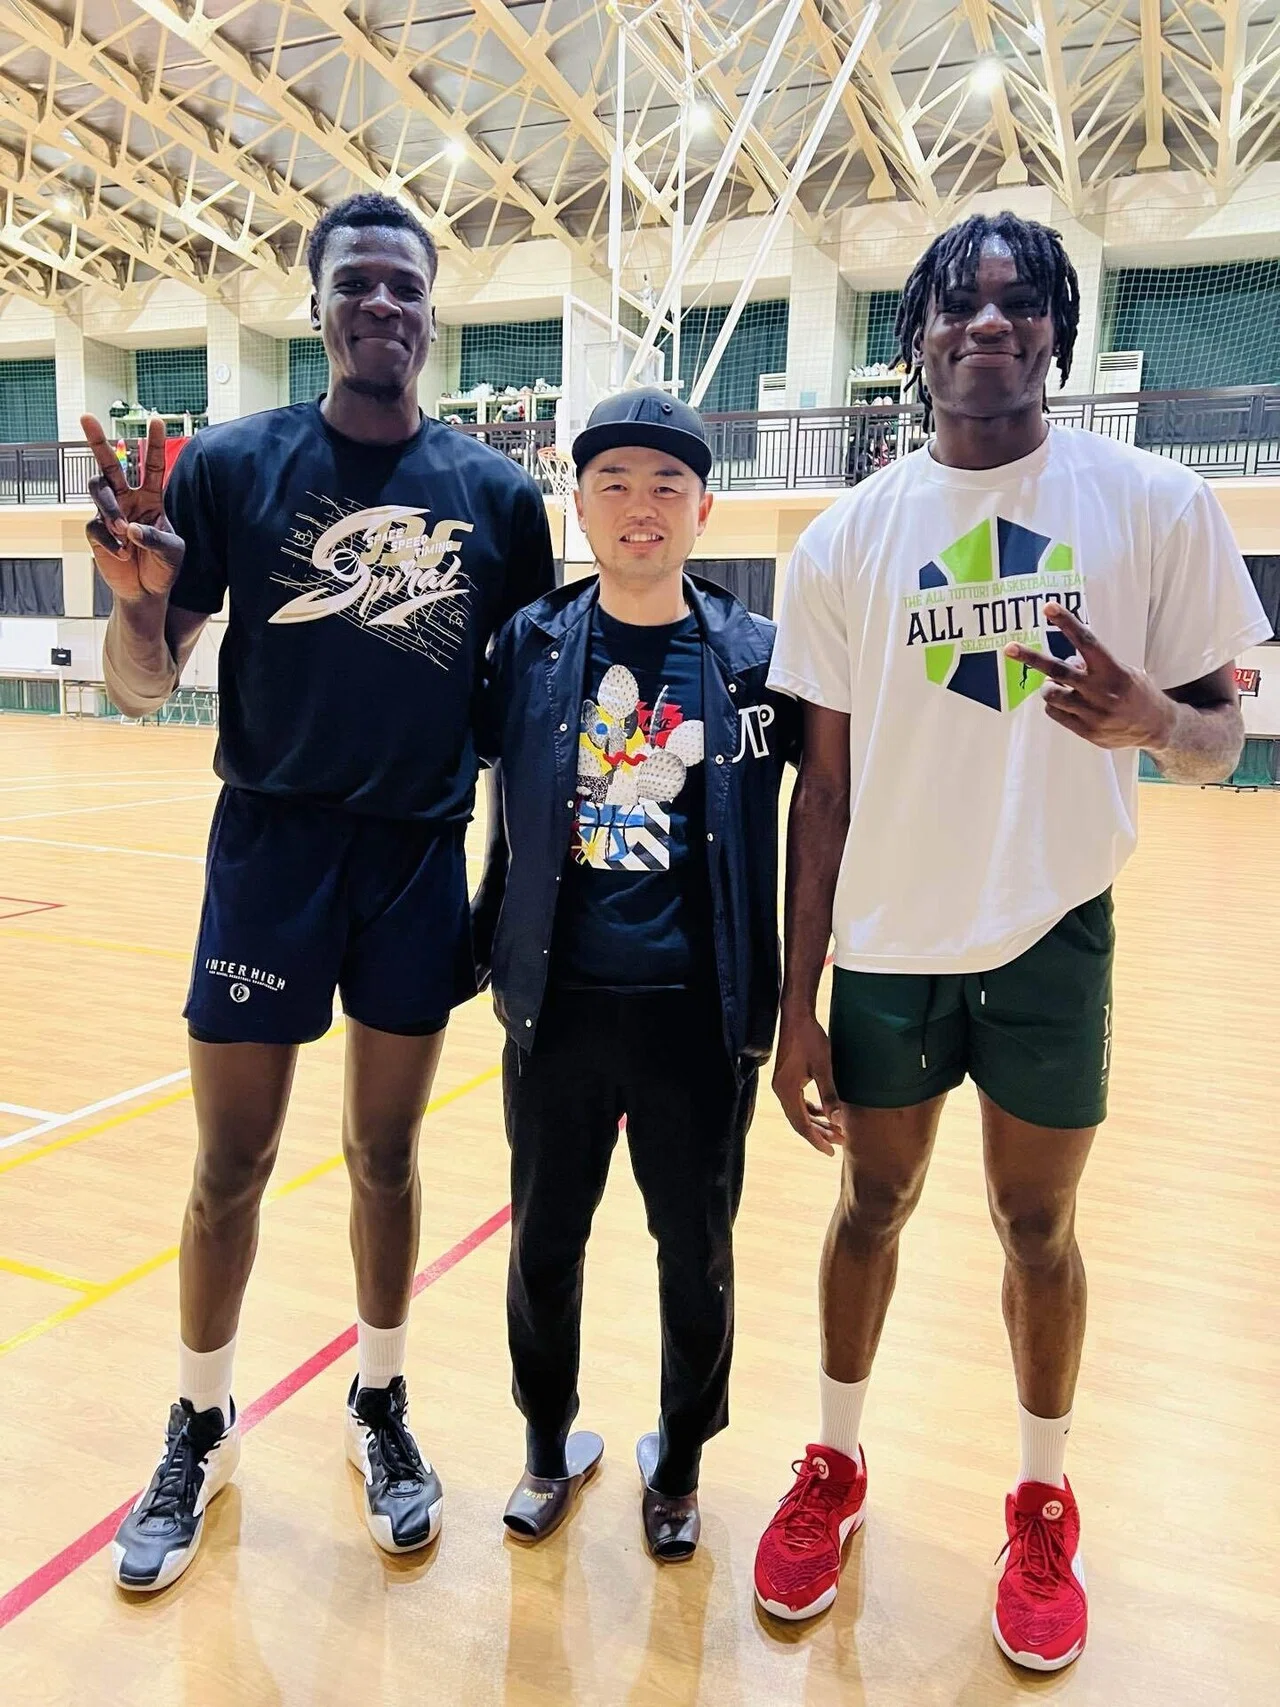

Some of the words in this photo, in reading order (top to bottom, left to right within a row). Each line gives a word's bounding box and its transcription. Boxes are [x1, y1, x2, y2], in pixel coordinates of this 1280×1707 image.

[390, 533, 428, 553] SPEED
[415, 540, 453, 560] TIMING
[902, 594, 922, 610] THE
[926, 590, 945, 605] ALL
[949, 585, 989, 600] TOTTORI
[992, 575, 1059, 595] BASKETBALL
[907, 606, 963, 645] ALL
[961, 634, 1007, 651] SELECTED
